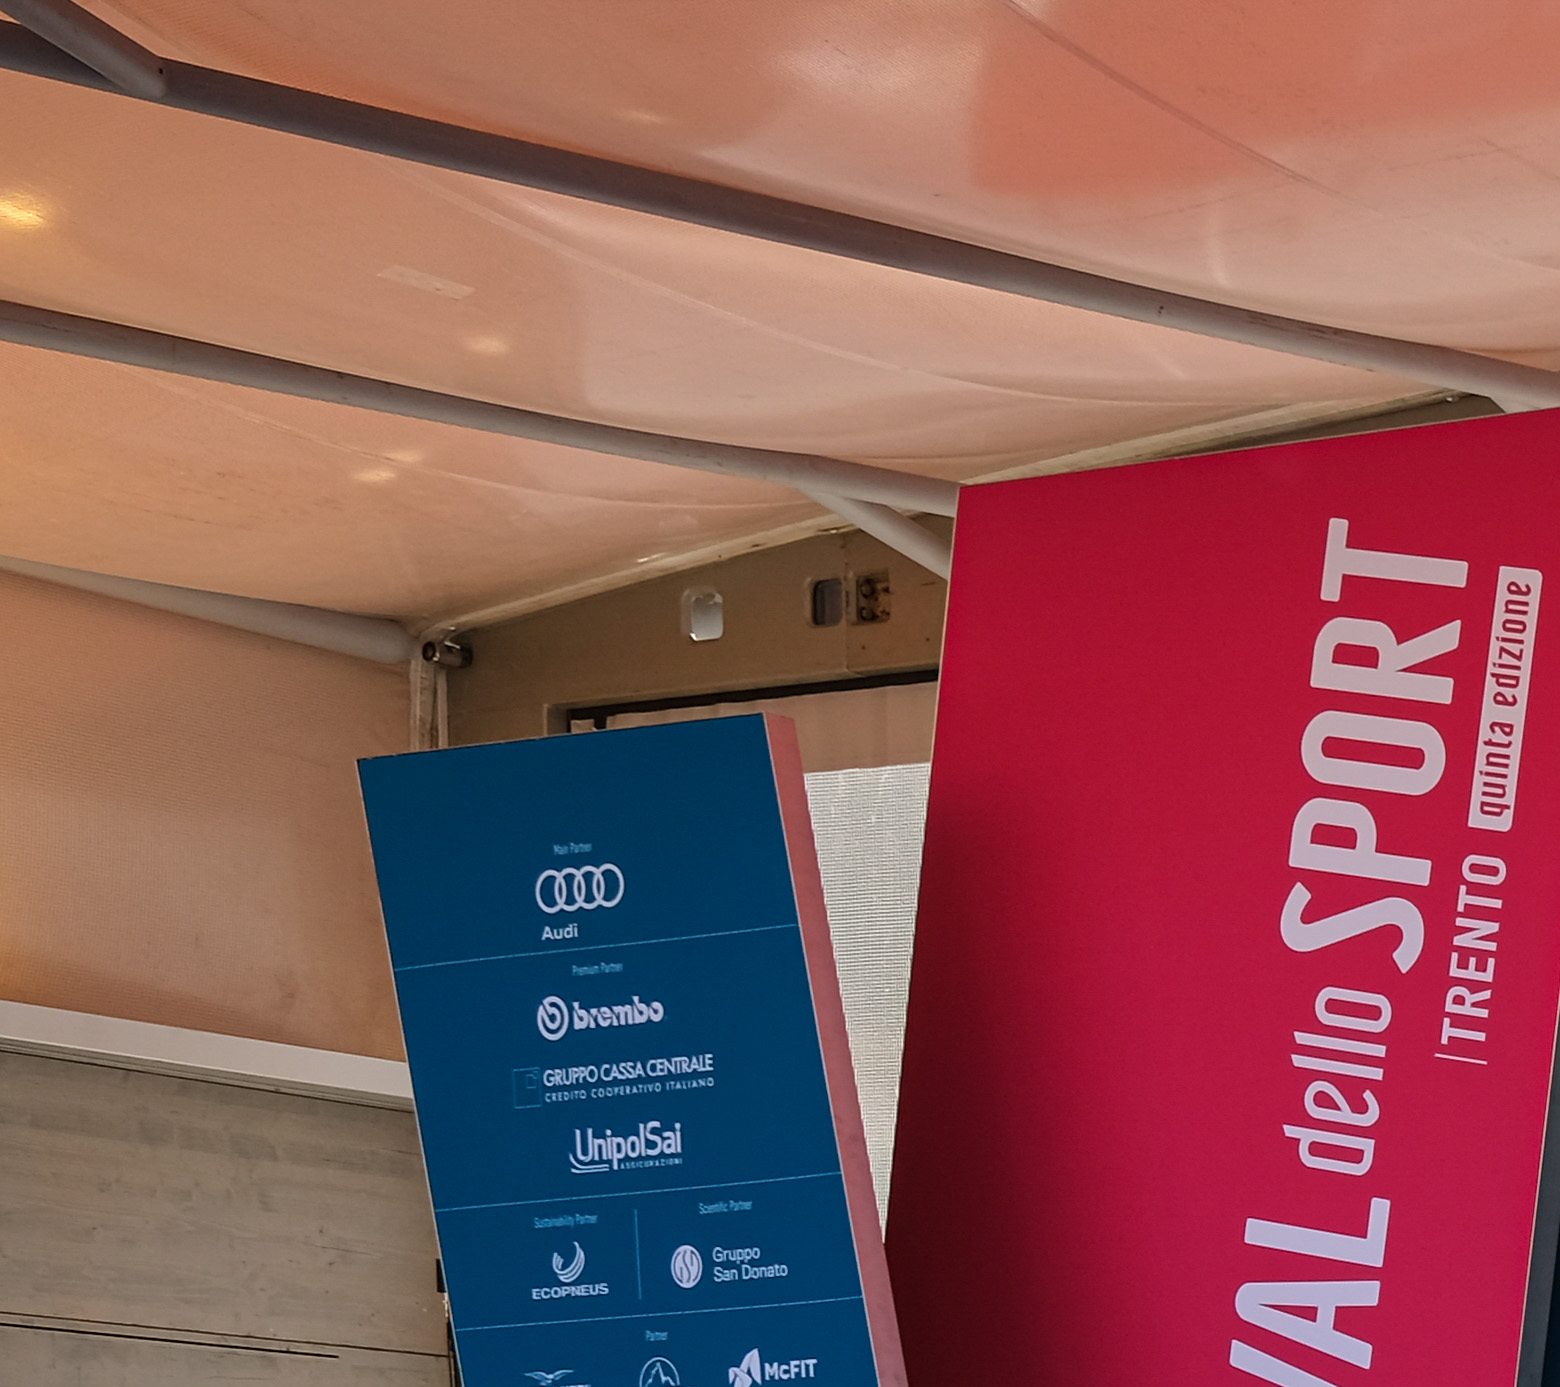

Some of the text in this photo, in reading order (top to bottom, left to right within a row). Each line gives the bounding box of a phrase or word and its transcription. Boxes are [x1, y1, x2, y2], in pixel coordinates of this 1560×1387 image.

[1280, 518, 1469, 973] SPORT
[1440, 580, 1531, 1046] TRENTO quinta edizione
[570, 842, 592, 855] Partner
[541, 923, 579, 940] Audi
[572, 962, 623, 976] Premium Partner
[572, 996, 665, 1030] brembo
[543, 1053, 714, 1087] GRUPPO CASSA CENTRALE
[545, 1077, 715, 1103] CREDITO COOPERATIVO ITALIANO
[1283, 985, 1392, 1177] dello
[574, 1120, 682, 1170] UnipolSai
[698, 1199, 752, 1215] Scientific Partner
[575, 1213, 598, 1225] Partner
[712, 1246, 761, 1264] Gruppo
[713, 1263, 788, 1282] San Donato
[532, 1283, 609, 1300] ECOPNEUS
[645, 1330, 668, 1341] Partner
[764, 1358, 818, 1381] McFIT
